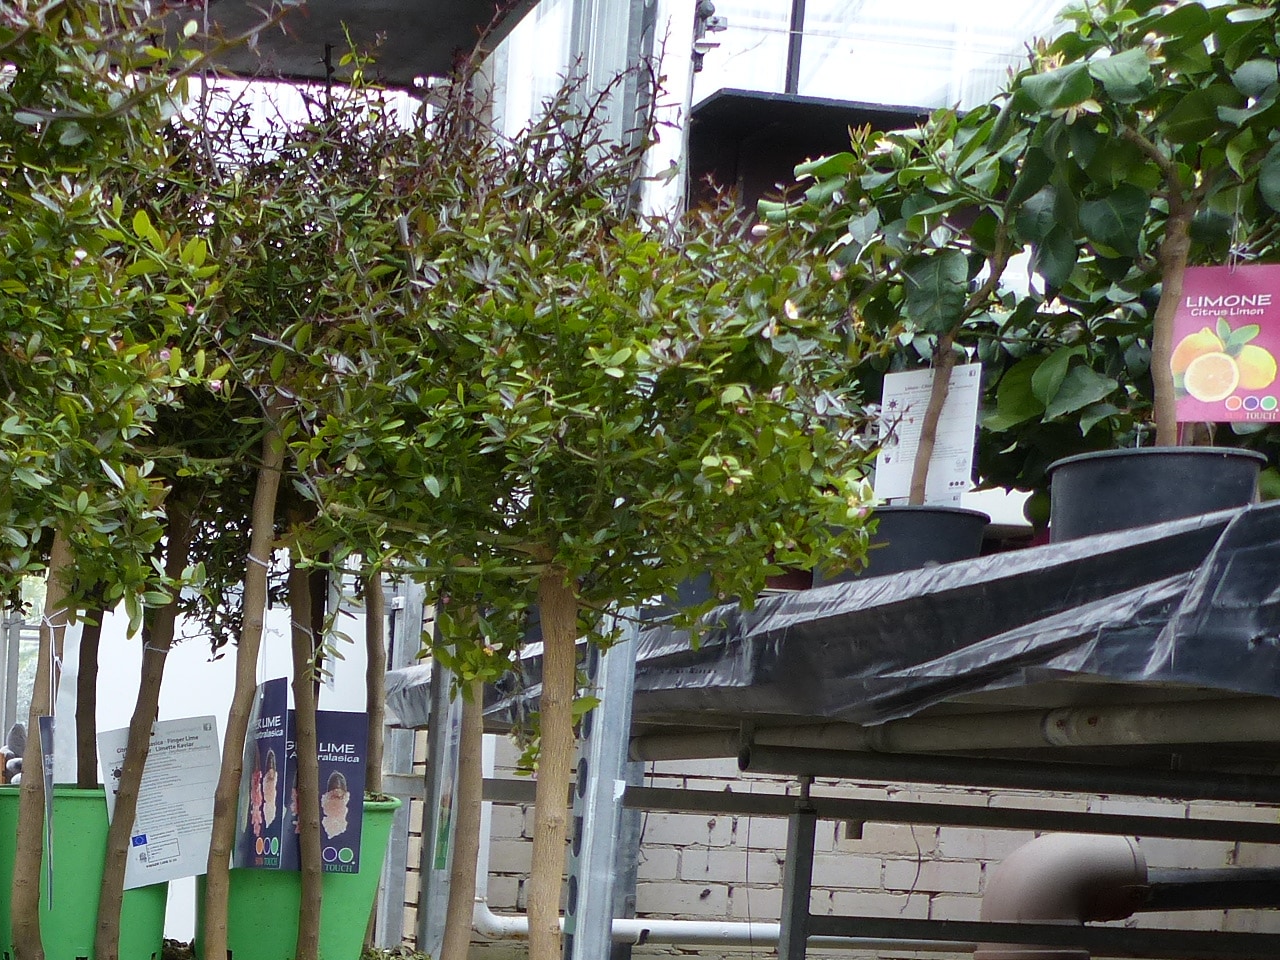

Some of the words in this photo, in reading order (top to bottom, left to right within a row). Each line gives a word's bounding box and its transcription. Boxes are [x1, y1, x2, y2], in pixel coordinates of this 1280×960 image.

[1186, 294, 1272, 307] LIMONE
[1191, 308, 1227, 316] Citrus
[1230, 308, 1264, 316] Limon
[262, 716, 281, 728] LIME
[319, 742, 355, 754] LIME
[324, 863, 353, 873] TOUCH
